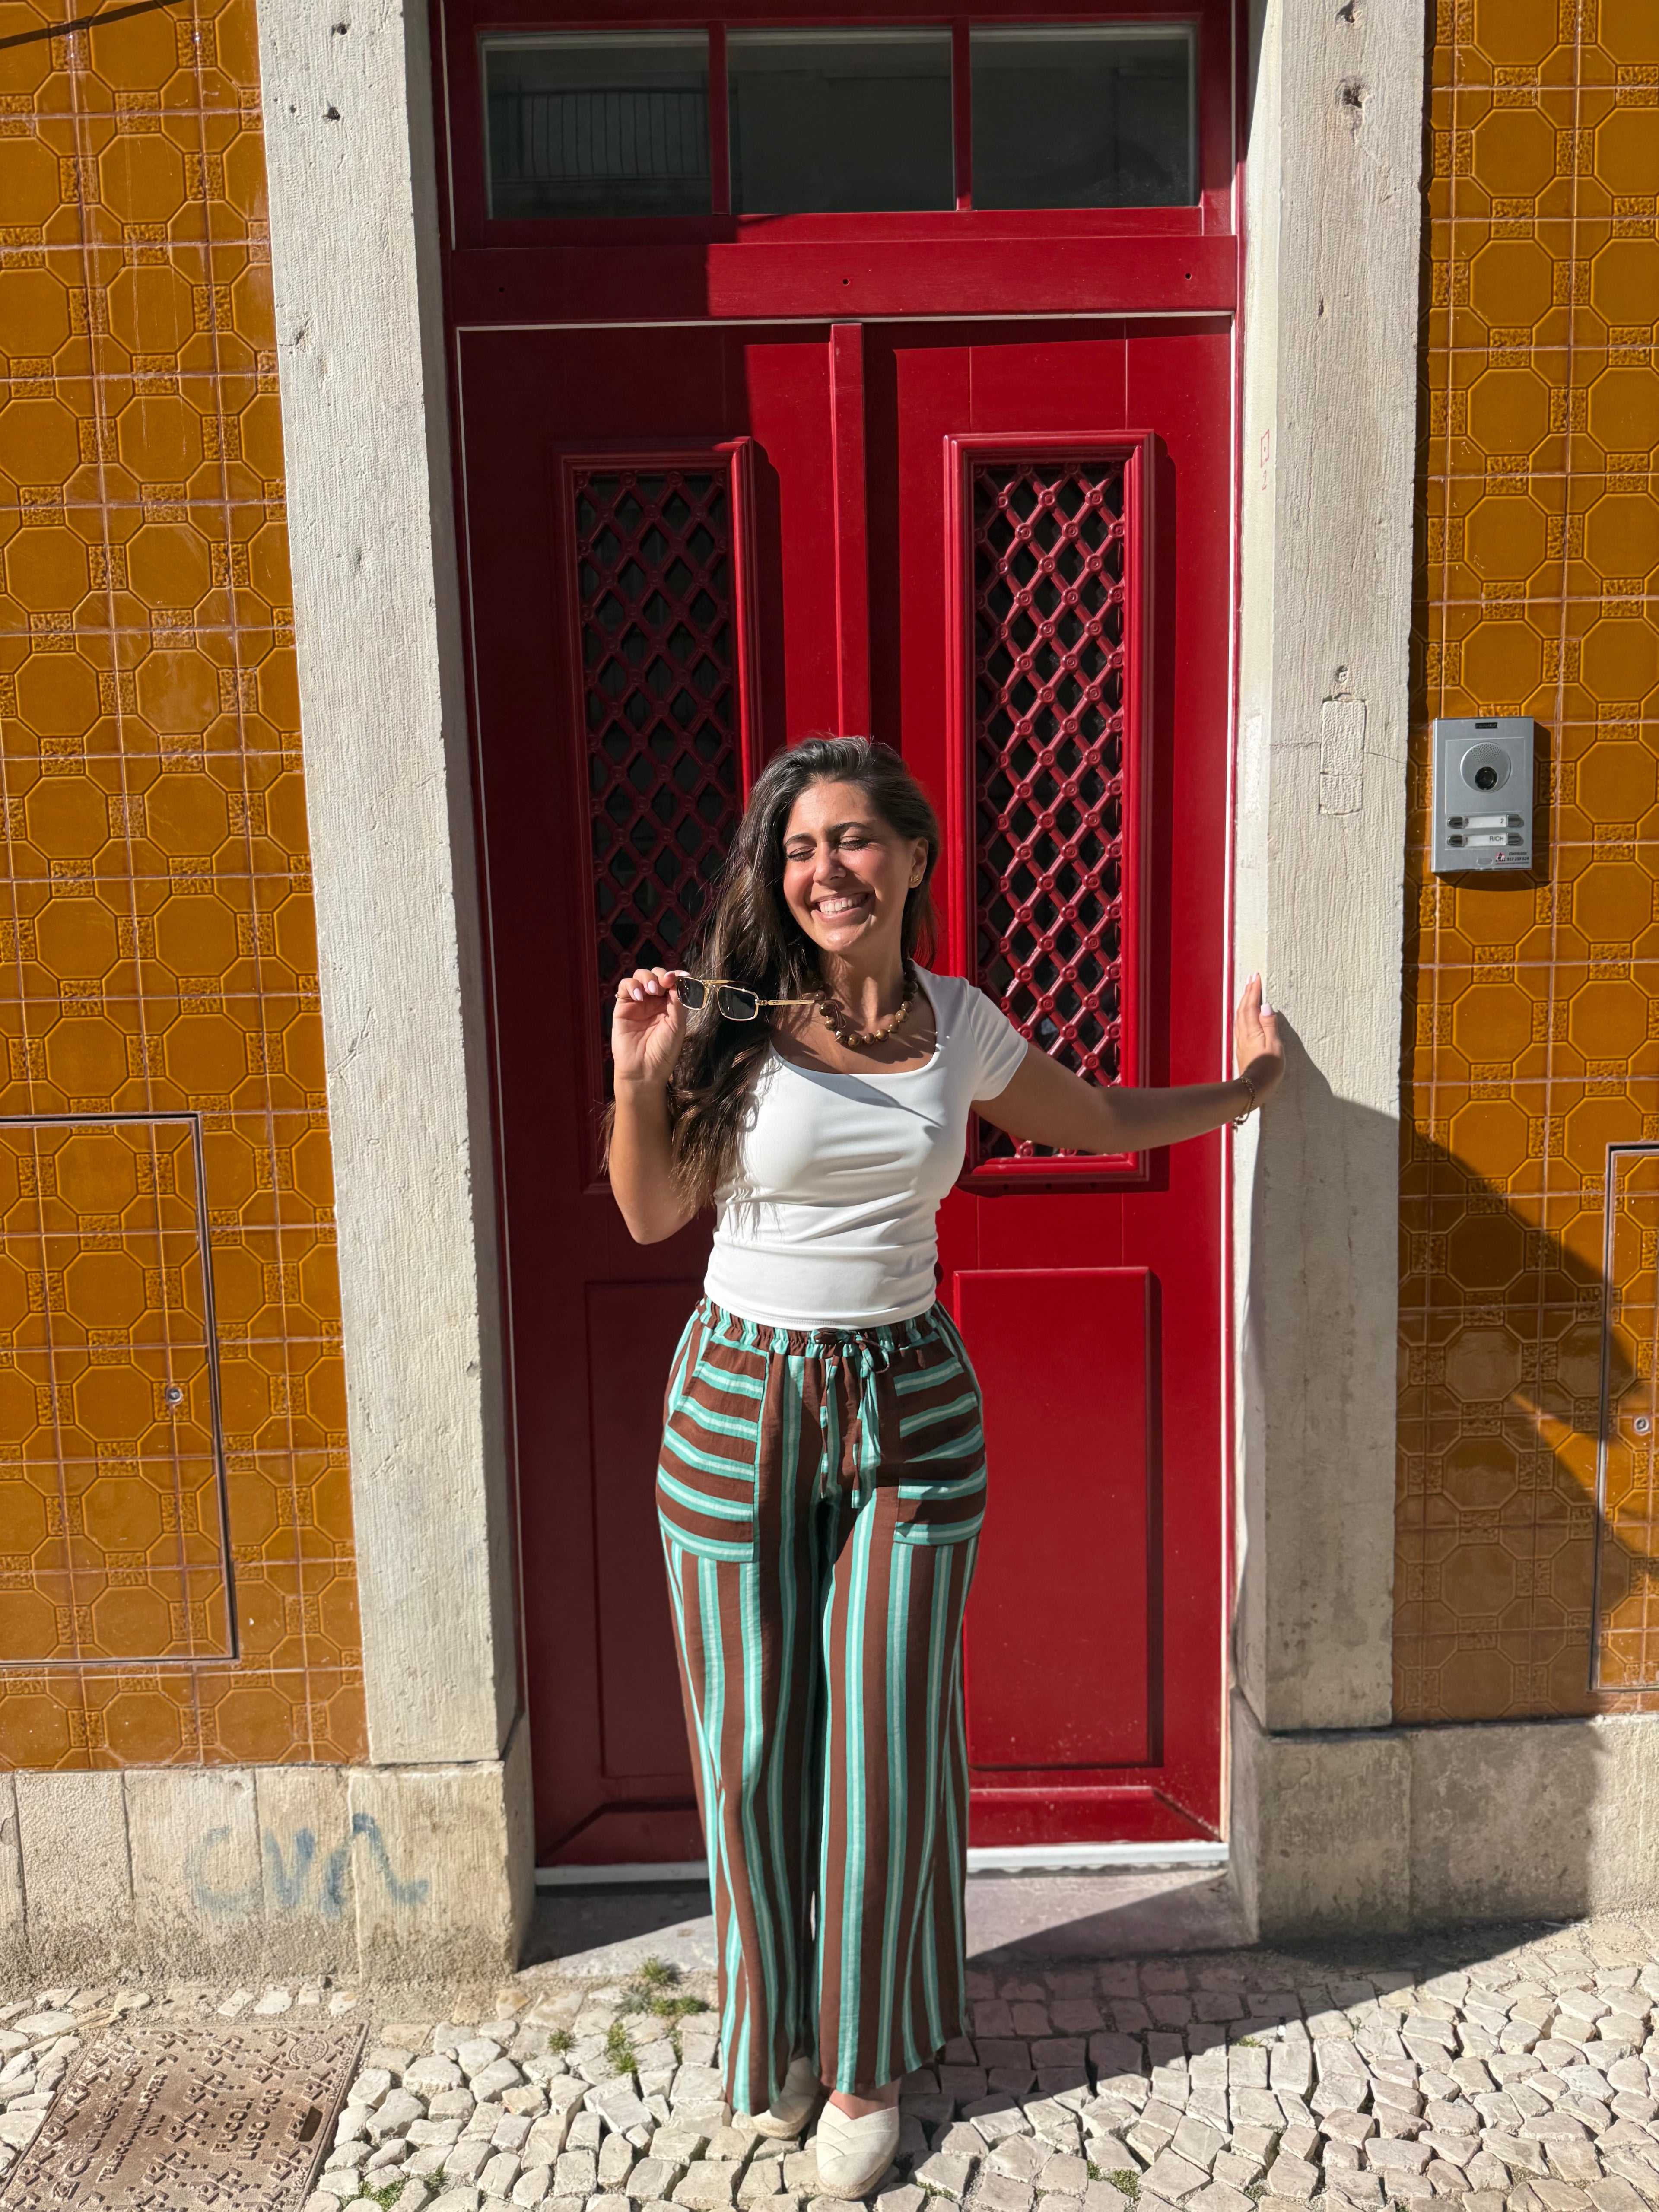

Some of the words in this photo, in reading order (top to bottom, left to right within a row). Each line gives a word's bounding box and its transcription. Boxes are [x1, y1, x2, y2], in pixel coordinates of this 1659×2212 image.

[211, 2097, 255, 2154] FUCOLI
[236, 2120, 270, 2161] LUSO
[258, 2088, 283, 2115] 400
